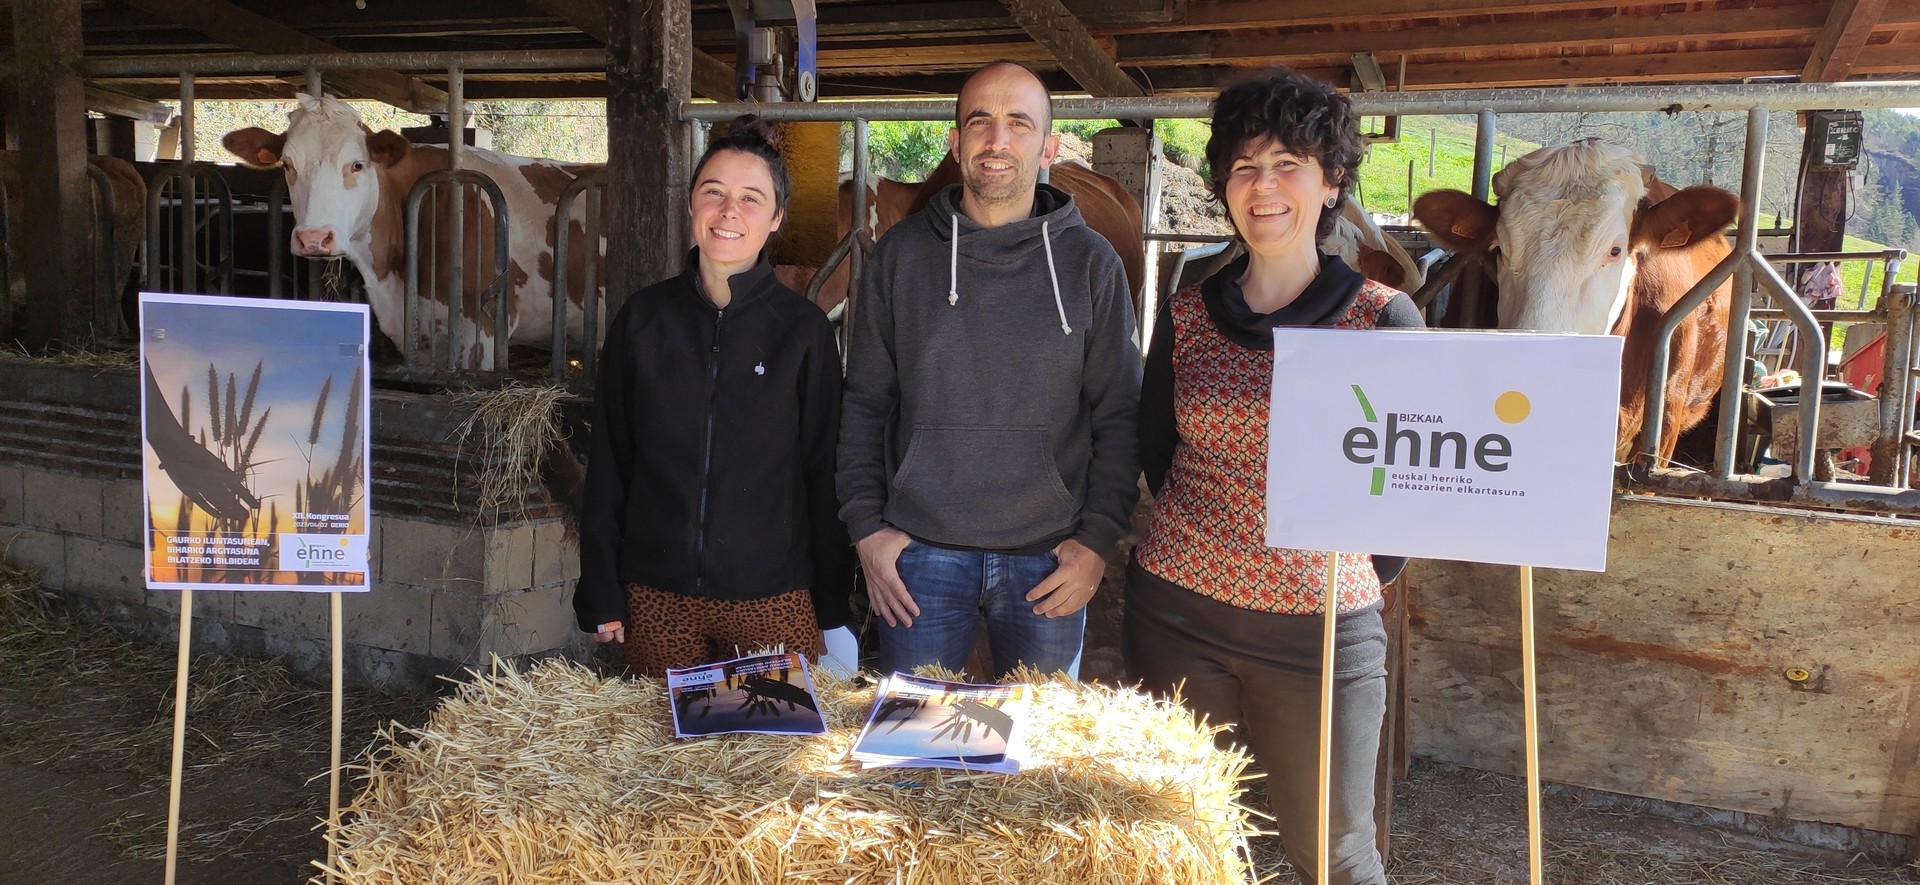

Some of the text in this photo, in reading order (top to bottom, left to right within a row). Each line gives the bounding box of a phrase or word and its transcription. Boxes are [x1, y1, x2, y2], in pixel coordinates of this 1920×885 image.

[1399, 413, 1444, 424] BIZKAIA
[1342, 412, 1513, 473] ehne
[1391, 472, 1473, 484] euskal herriko
[1391, 482, 1525, 497] nekazarien elkartasuna
[306, 512, 349, 522] Kongresua
[166, 536, 270, 547] GAURKO ILUNTASUNEAN,
[166, 546, 260, 556] BIHARKO ARGITASUNA
[296, 544, 345, 560] ehne
[167, 556, 260, 566] BILATZEKO IBILBIDEAK
